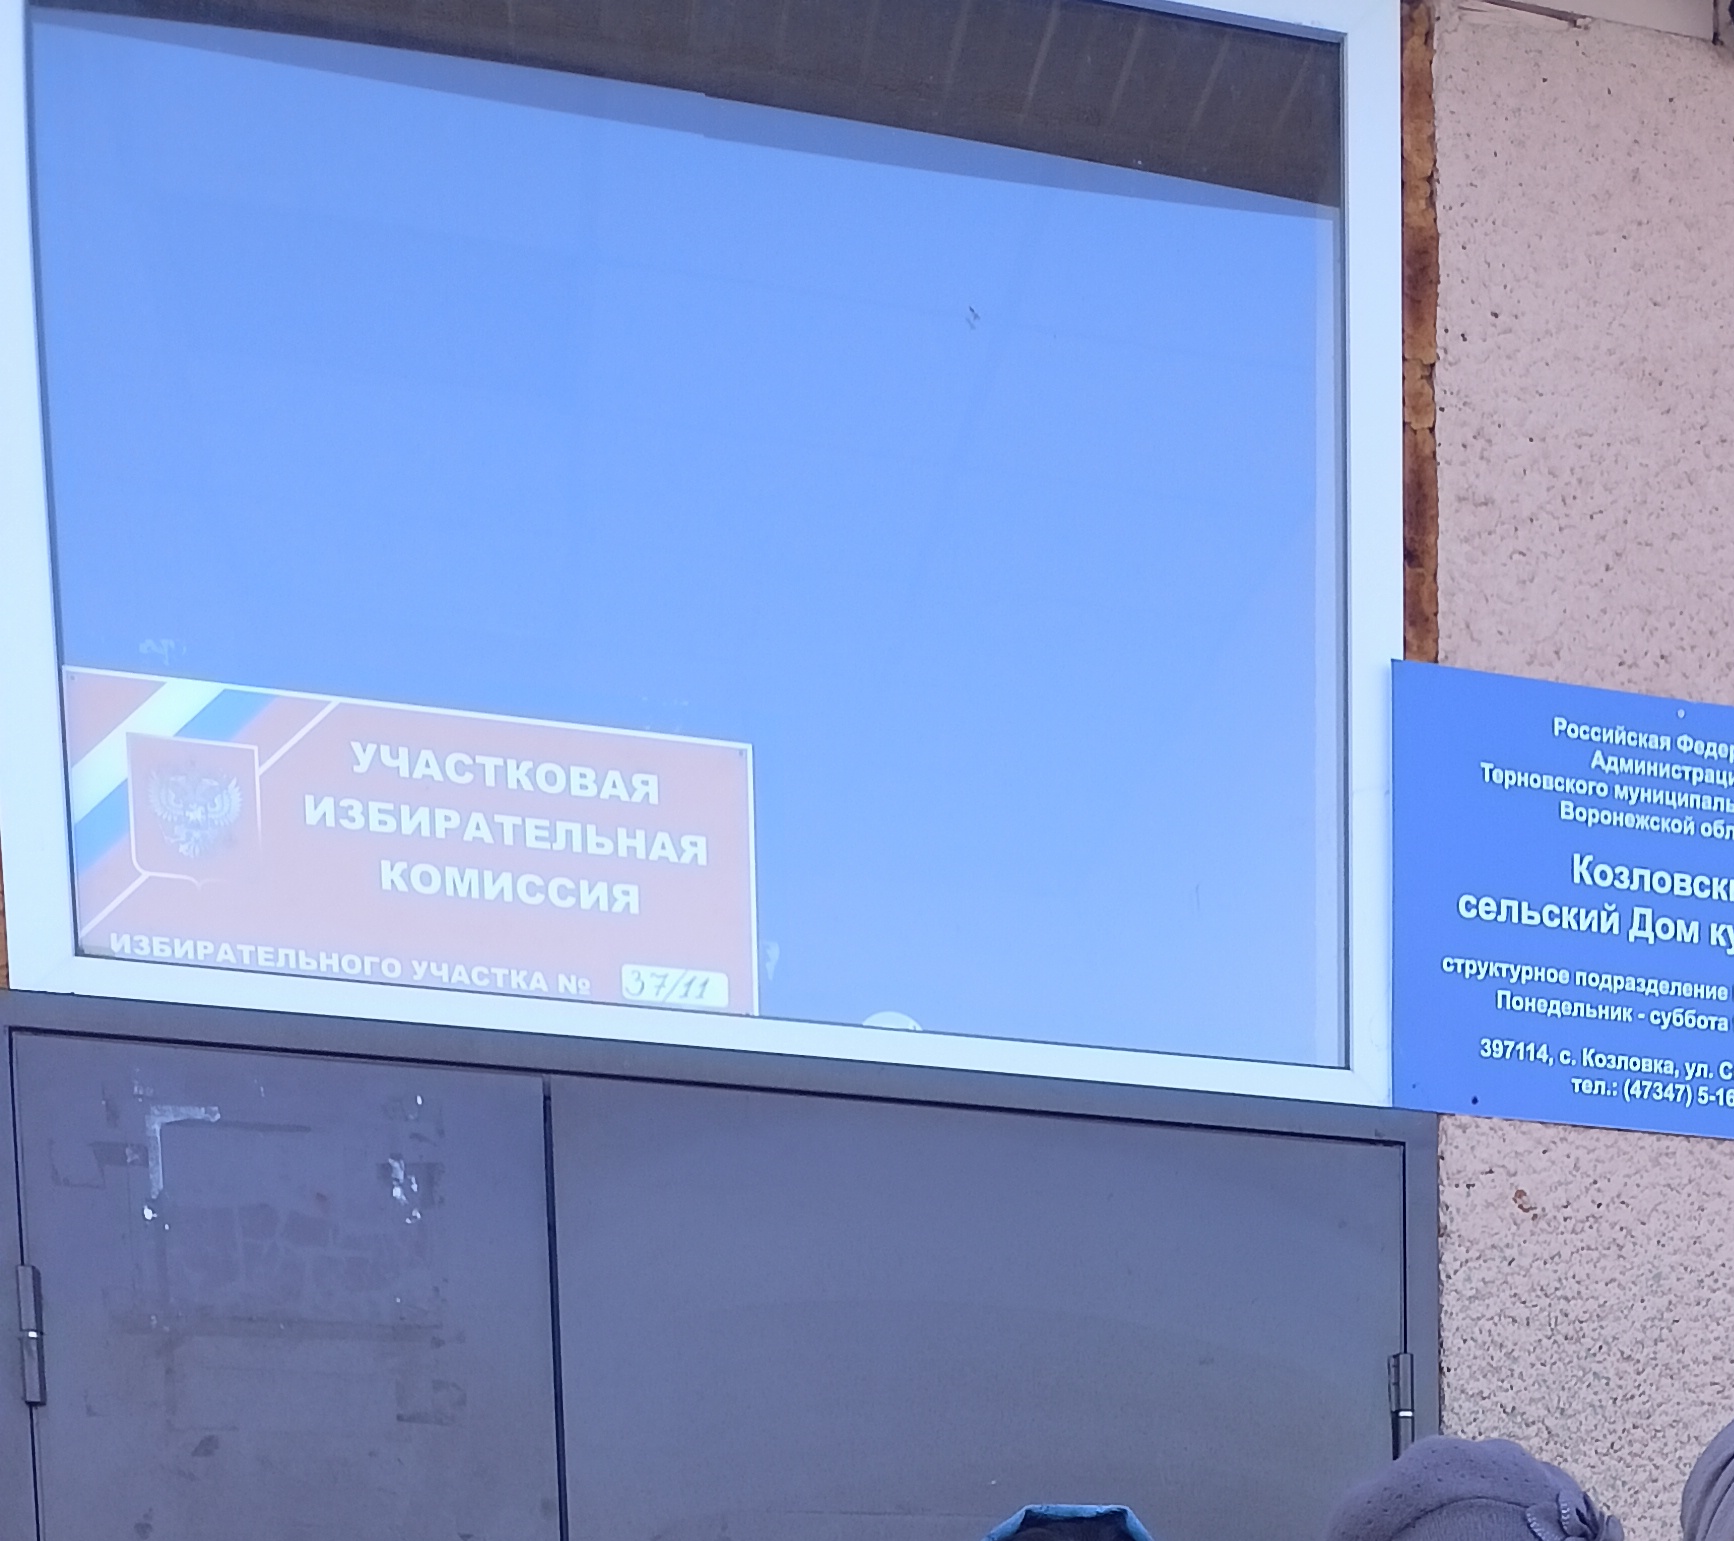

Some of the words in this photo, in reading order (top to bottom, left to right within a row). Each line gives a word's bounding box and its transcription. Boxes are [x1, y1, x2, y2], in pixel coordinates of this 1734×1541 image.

[1553, 716, 1671, 752] Российская
[350, 740, 660, 806] УЧАСТКОВАЯ
[1480, 761, 1608, 798] Терновского
[303, 794, 709, 866] ИЗБИРАТЕЛЬНАЯ
[1559, 800, 1696, 836] Воронежской
[379, 859, 642, 915] КОМИССИЯ
[1457, 893, 1621, 936] сельский
[1628, 907, 1700, 945] Дом
[109, 931, 402, 979] ИЗБИРАТЕЛЬНОГО
[411, 959, 549, 994] УЧАСТКА
[557, 973, 592, 996] №
[1441, 954, 1571, 985] структурное
[1574, 970, 1729, 1003] подразделение
[1496, 988, 1634, 1024] Понедельник
[1649, 1010, 1729, 1034] суббота
[1479, 1037, 1555, 1067] 397114,
[1559, 1050, 1577, 1067] с.
[1581, 1047, 1680, 1078] Козловка,
[1684, 1062, 1716, 1080] ул.
[1570, 1076, 1619, 1099] тел.:
[1623, 1078, 1694, 1108] (47347)
